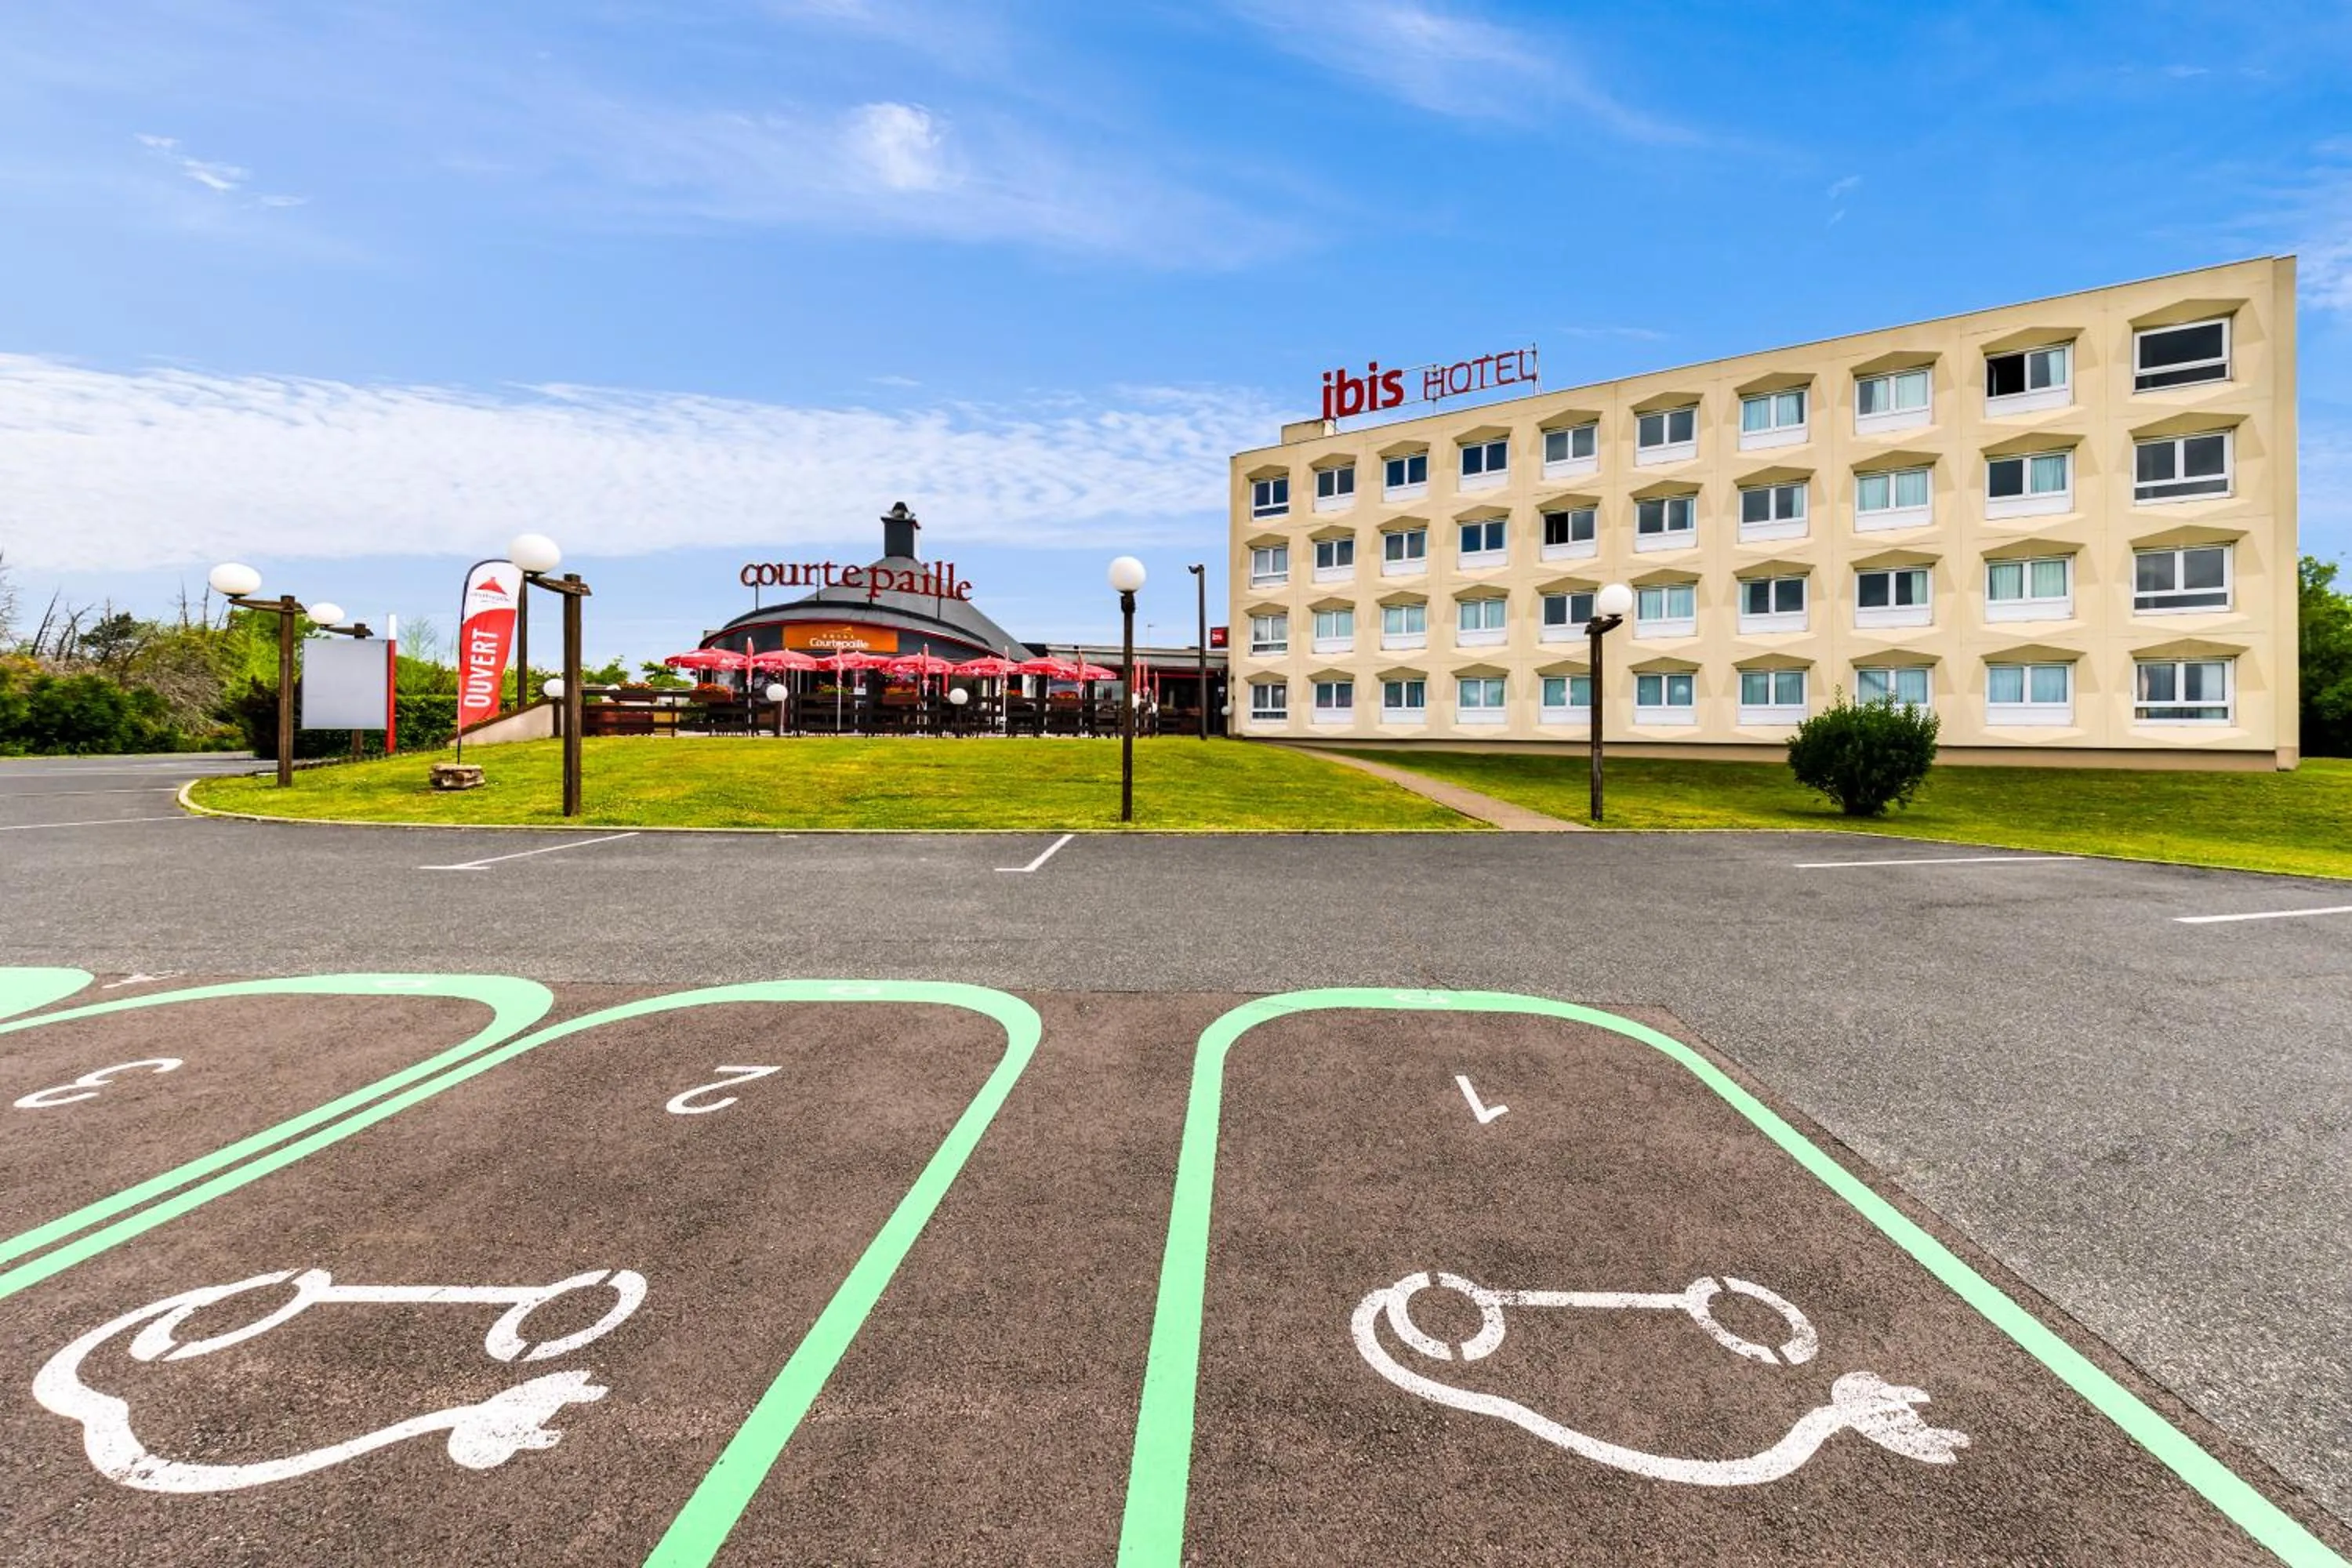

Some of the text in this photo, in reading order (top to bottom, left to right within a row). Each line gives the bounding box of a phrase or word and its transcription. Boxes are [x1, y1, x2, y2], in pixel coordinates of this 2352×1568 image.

[1323, 350, 1537, 420] ibis HOTEL
[740, 561, 973, 601] courtepaille
[809, 637, 870, 649] Courtepaille
[463, 628, 500, 709] OUVERT
[13, 1058, 183, 1108] 3
[666, 1065, 782, 1114] 2
[1454, 1075, 1509, 1123] 1
